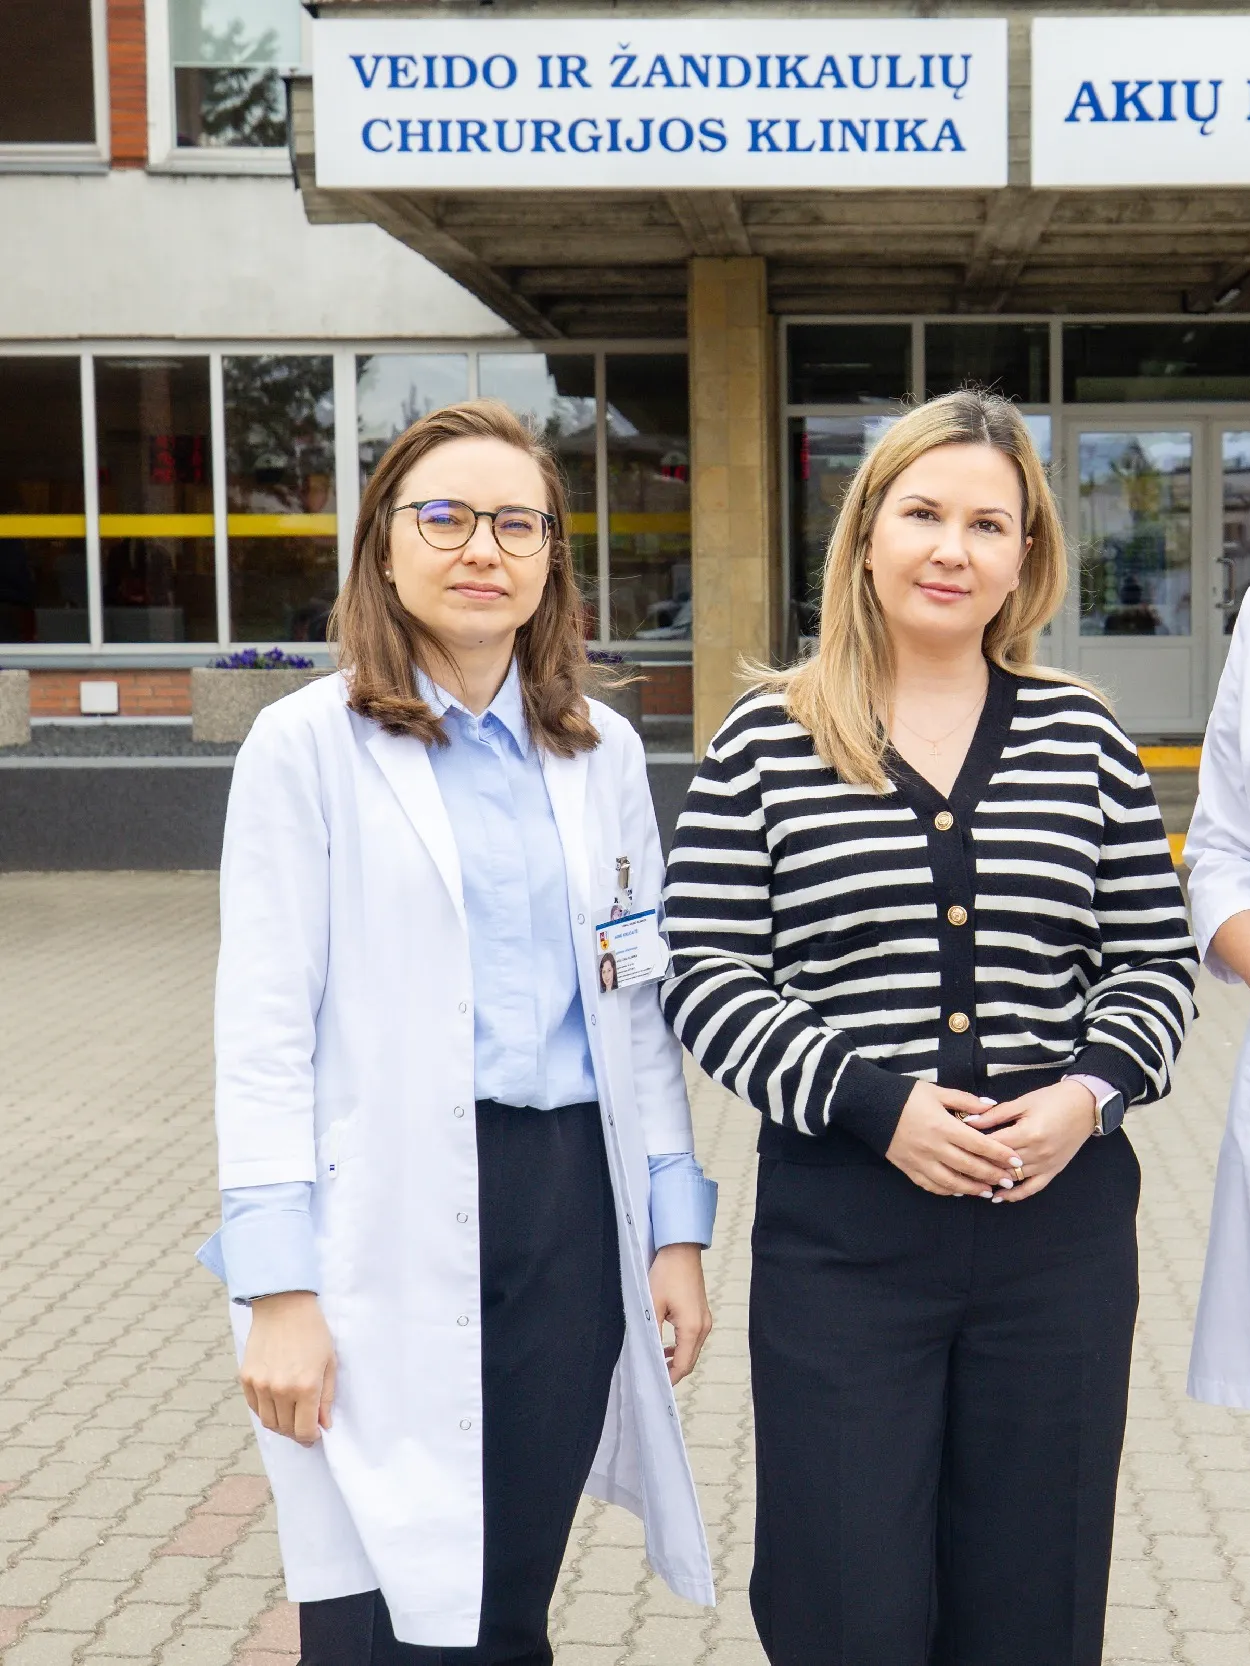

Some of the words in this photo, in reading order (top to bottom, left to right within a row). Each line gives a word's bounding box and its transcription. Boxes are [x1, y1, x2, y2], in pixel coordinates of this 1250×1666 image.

[350, 54, 518, 91] VEIDO
[538, 54, 592, 90] IR
[610, 43, 972, 100] ŽANDIKAULIŲ
[360, 117, 728, 154] CHIRURGIJOS
[747, 118, 967, 154] KLINIKA
[1064, 79, 1223, 137] AKIŲ
